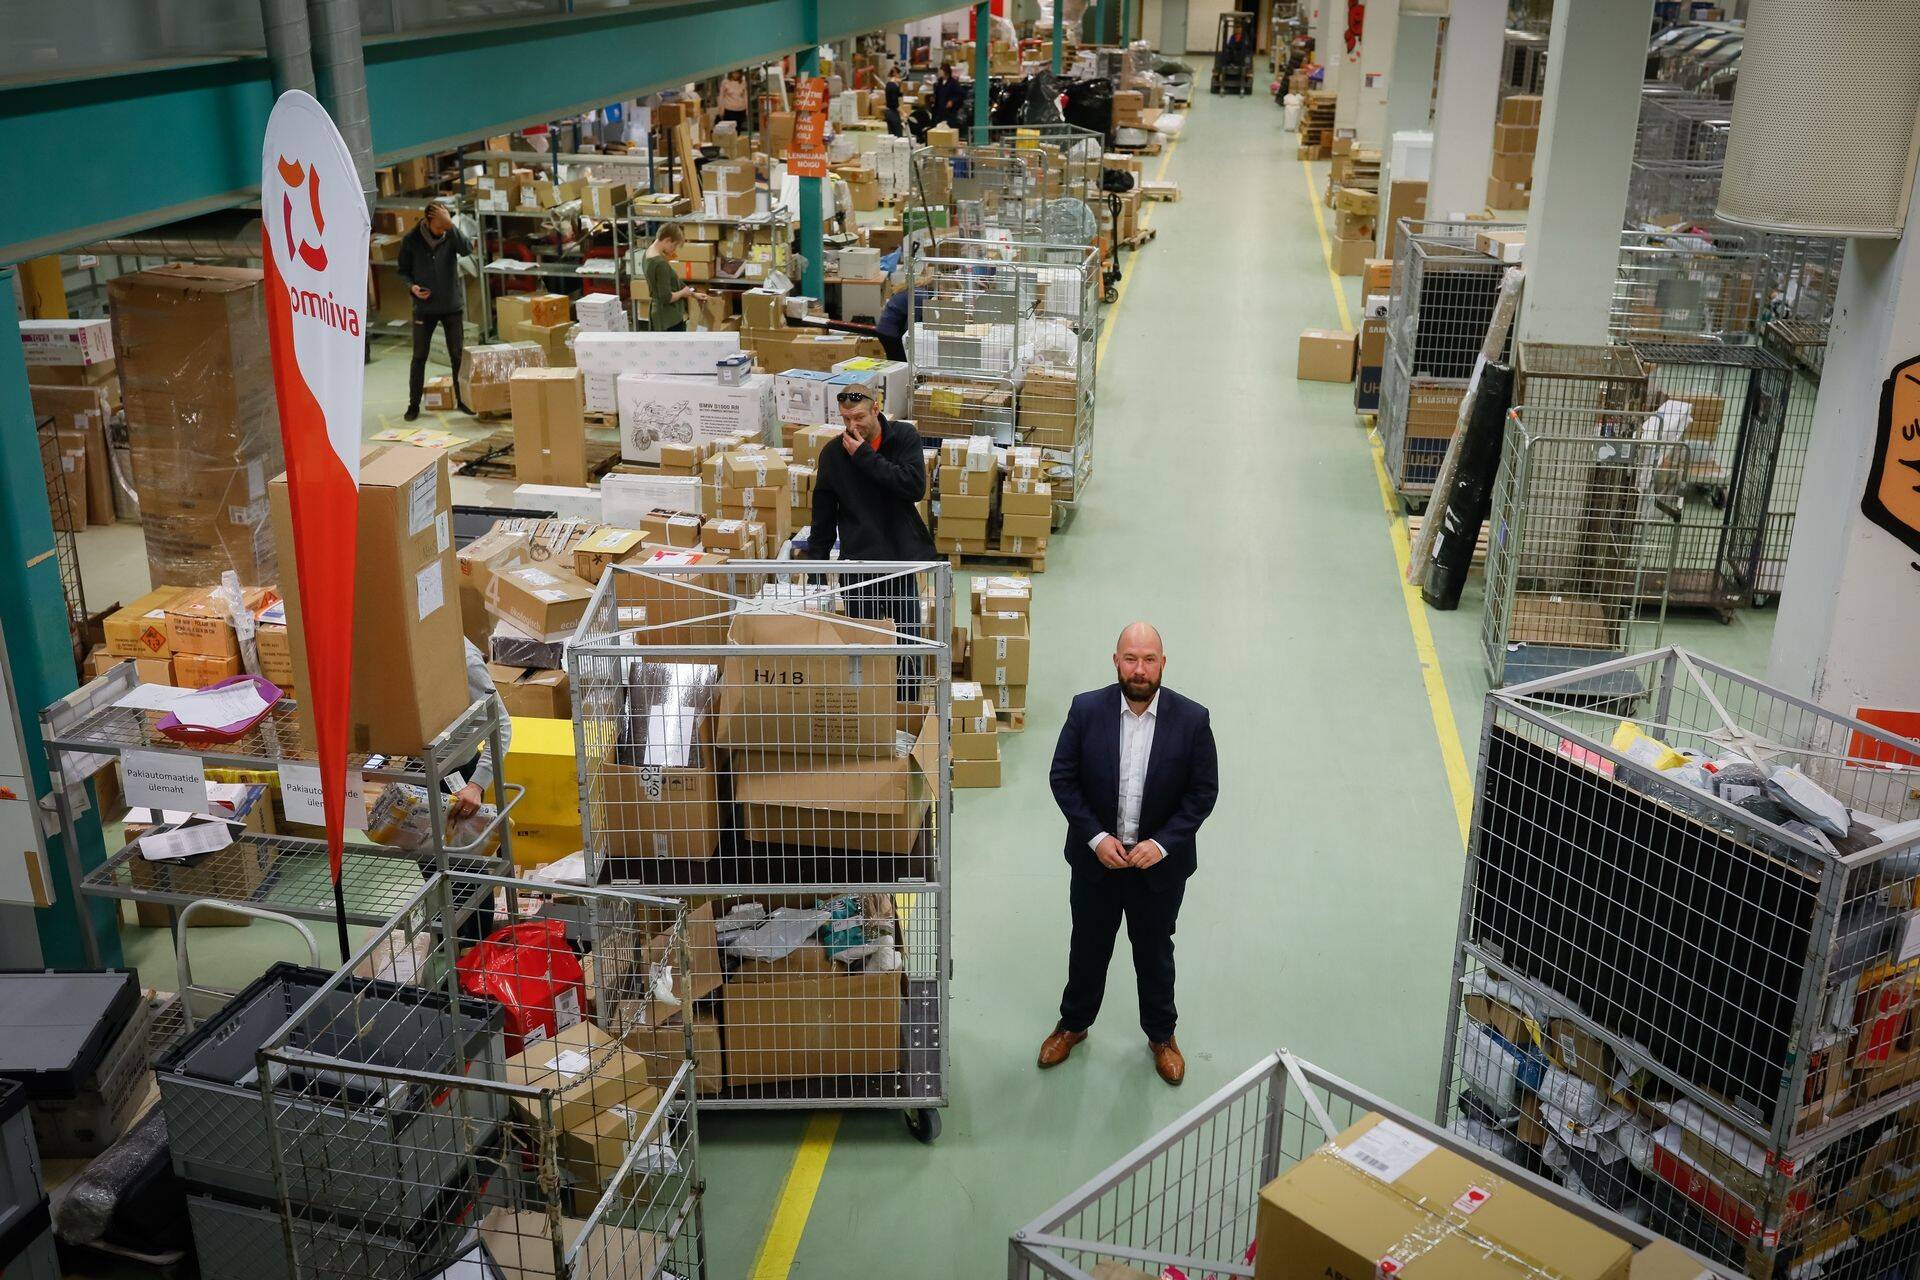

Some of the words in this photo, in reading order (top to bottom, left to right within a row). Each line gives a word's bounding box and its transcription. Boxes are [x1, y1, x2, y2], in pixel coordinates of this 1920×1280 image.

[290, 286, 360, 337] omniva
[1417, 396, 1458, 405] SAMSUNG
[754, 669, 804, 685] H/18
[126, 768, 200, 784] Pakiautomaatide
[148, 783, 184, 795] ülemaht
